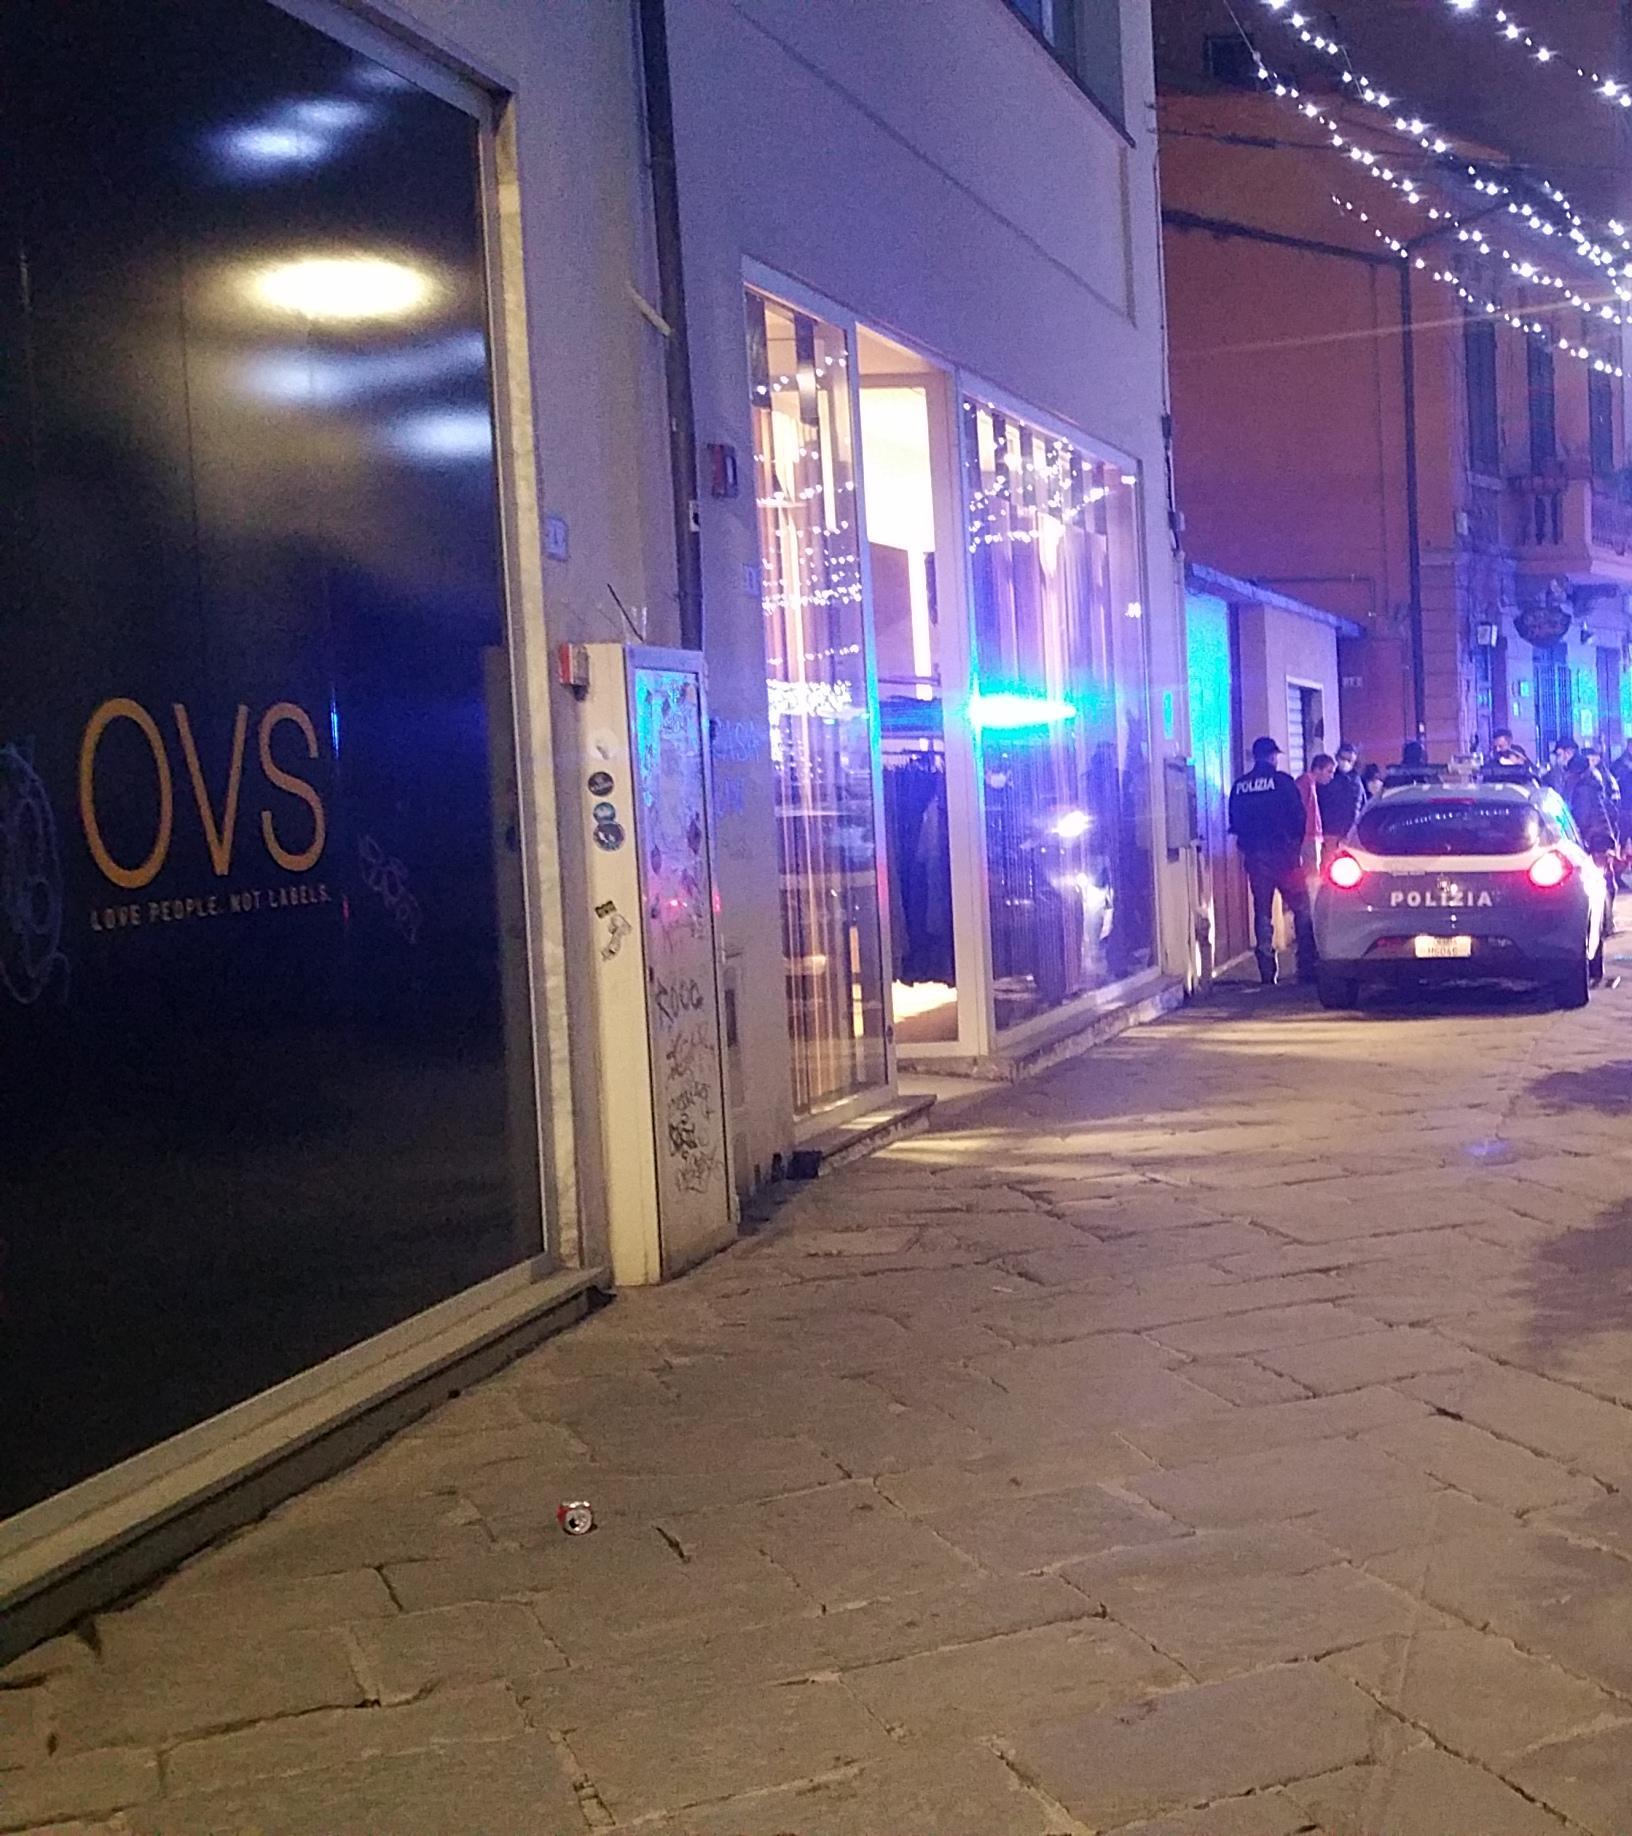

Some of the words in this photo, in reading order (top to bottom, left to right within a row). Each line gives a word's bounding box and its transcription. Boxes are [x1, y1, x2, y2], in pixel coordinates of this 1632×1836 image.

[80, 697, 326, 889] OVS
[1236, 777, 1276, 795] POLIZIA
[90, 903, 142, 931] LOVE
[229, 890, 262, 913] NOT
[1389, 890, 1494, 907] POLIZIA
